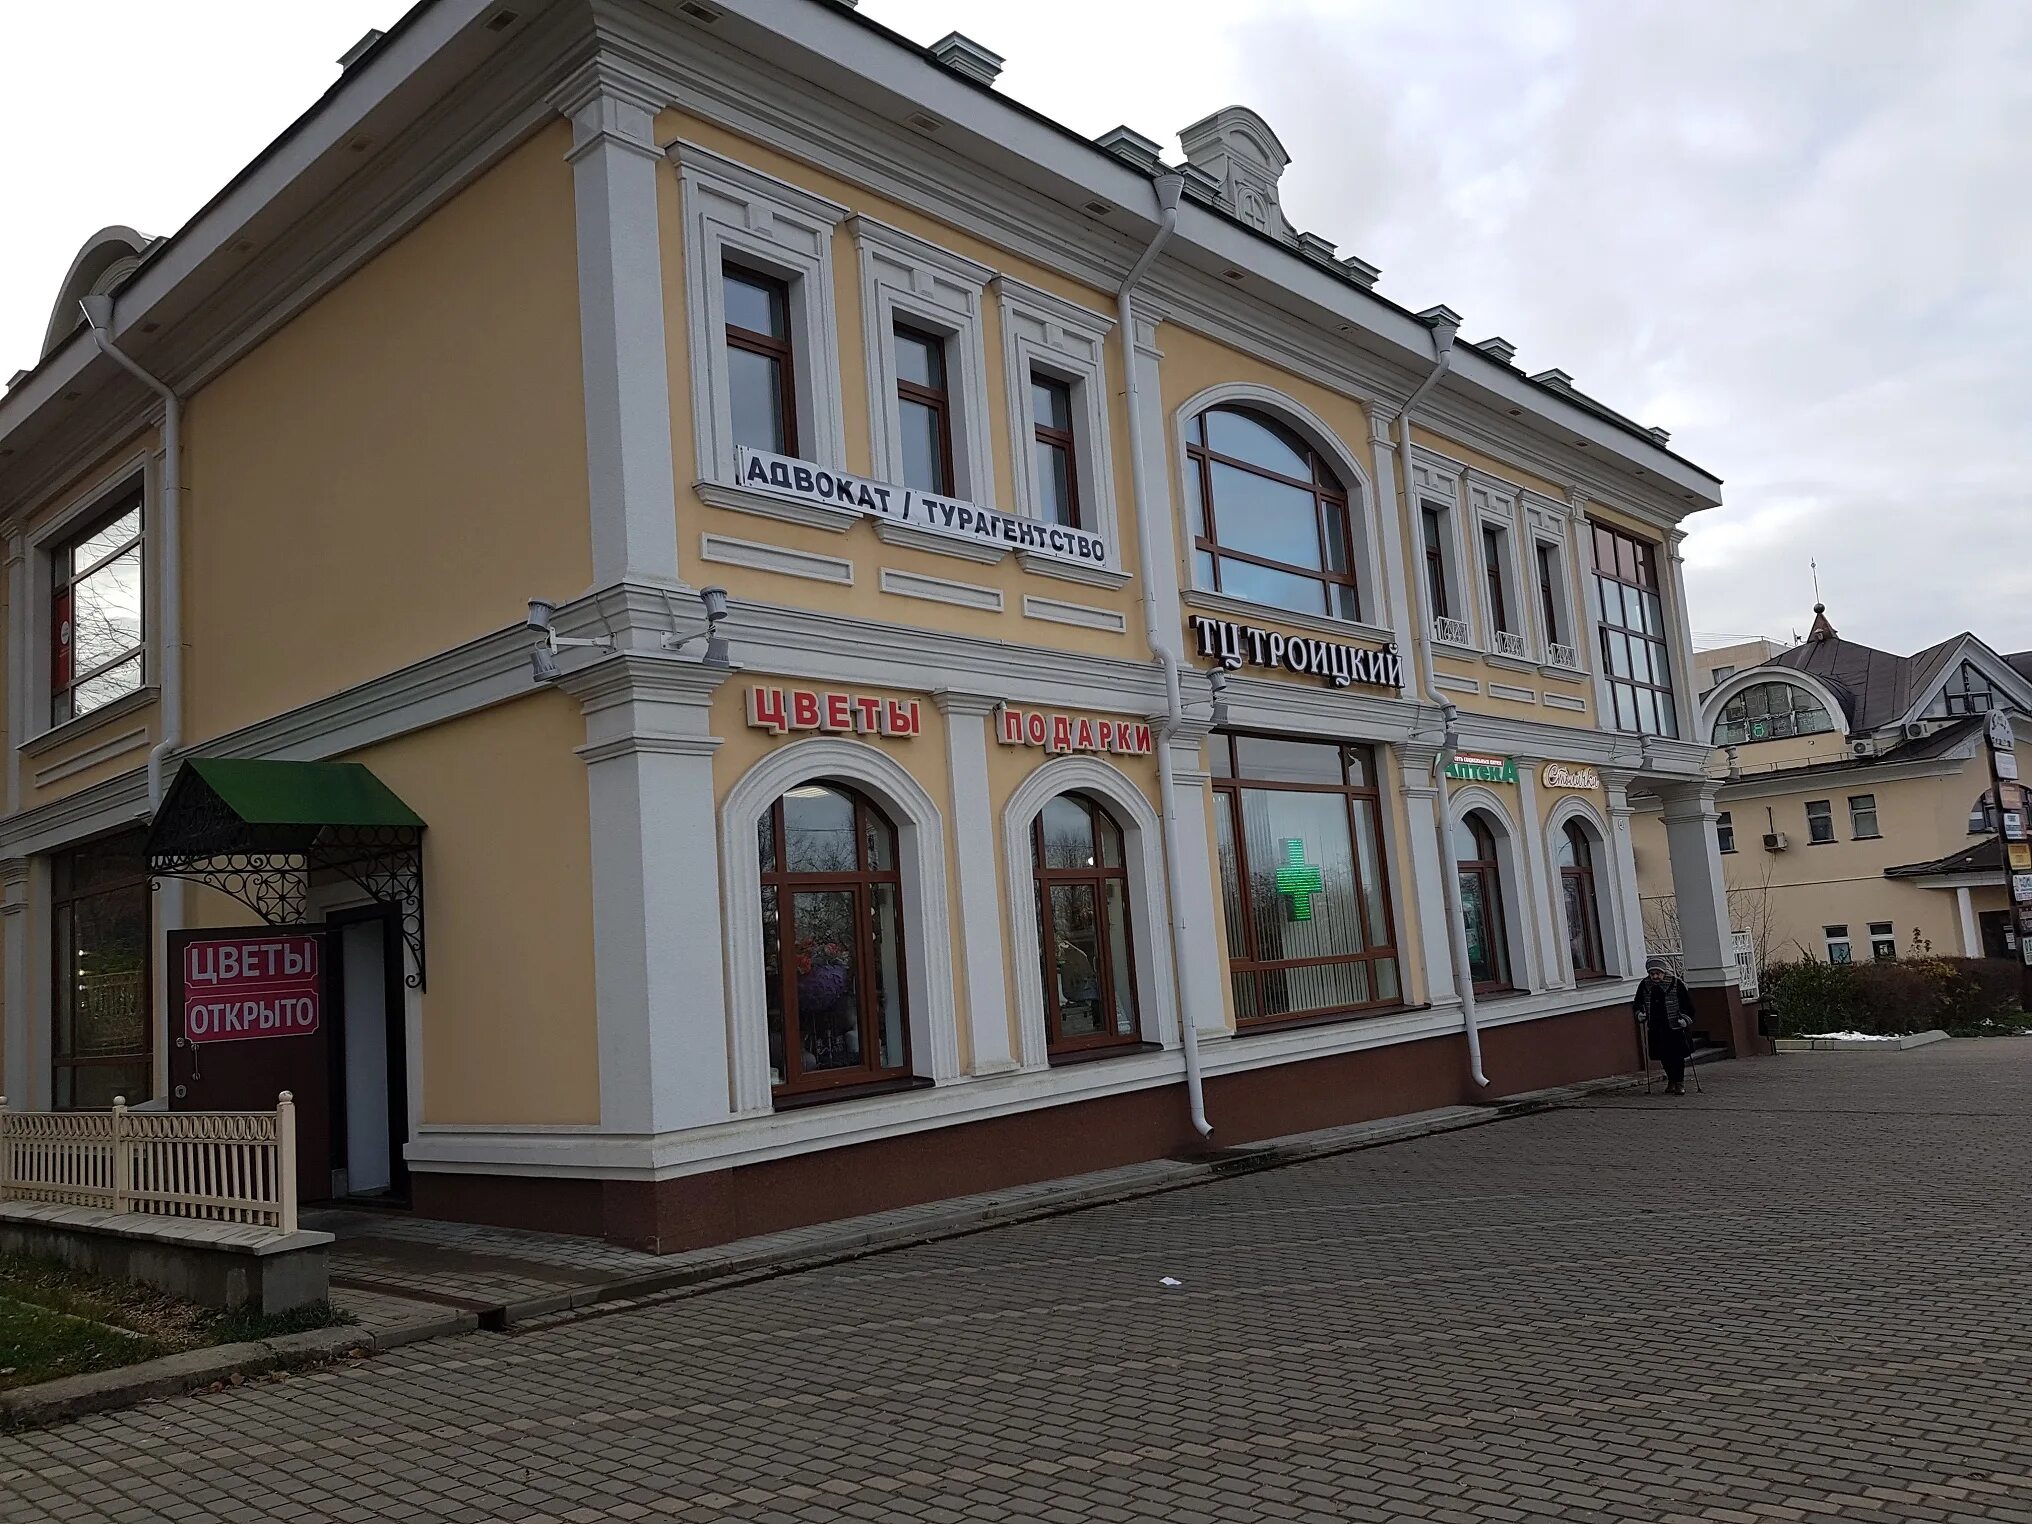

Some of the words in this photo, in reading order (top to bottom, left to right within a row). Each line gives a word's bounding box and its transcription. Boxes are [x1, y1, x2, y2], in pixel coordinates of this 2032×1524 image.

[747, 456, 891, 513] АДВОКАТ
[902, 491, 911, 520] /
[922, 498, 1106, 562] ТУРАГЕНТСТВО
[1194, 614, 1243, 669] ТЦ
[1246, 625, 1405, 688] ТРОИЦКИЙ
[750, 685, 921, 736] ЦВЕТЫ
[1002, 708, 1154, 755] ПОДАРКИ
[191, 942, 311, 984] ЦВЕТЫ
[190, 998, 313, 1034] ОТКРЫТО
